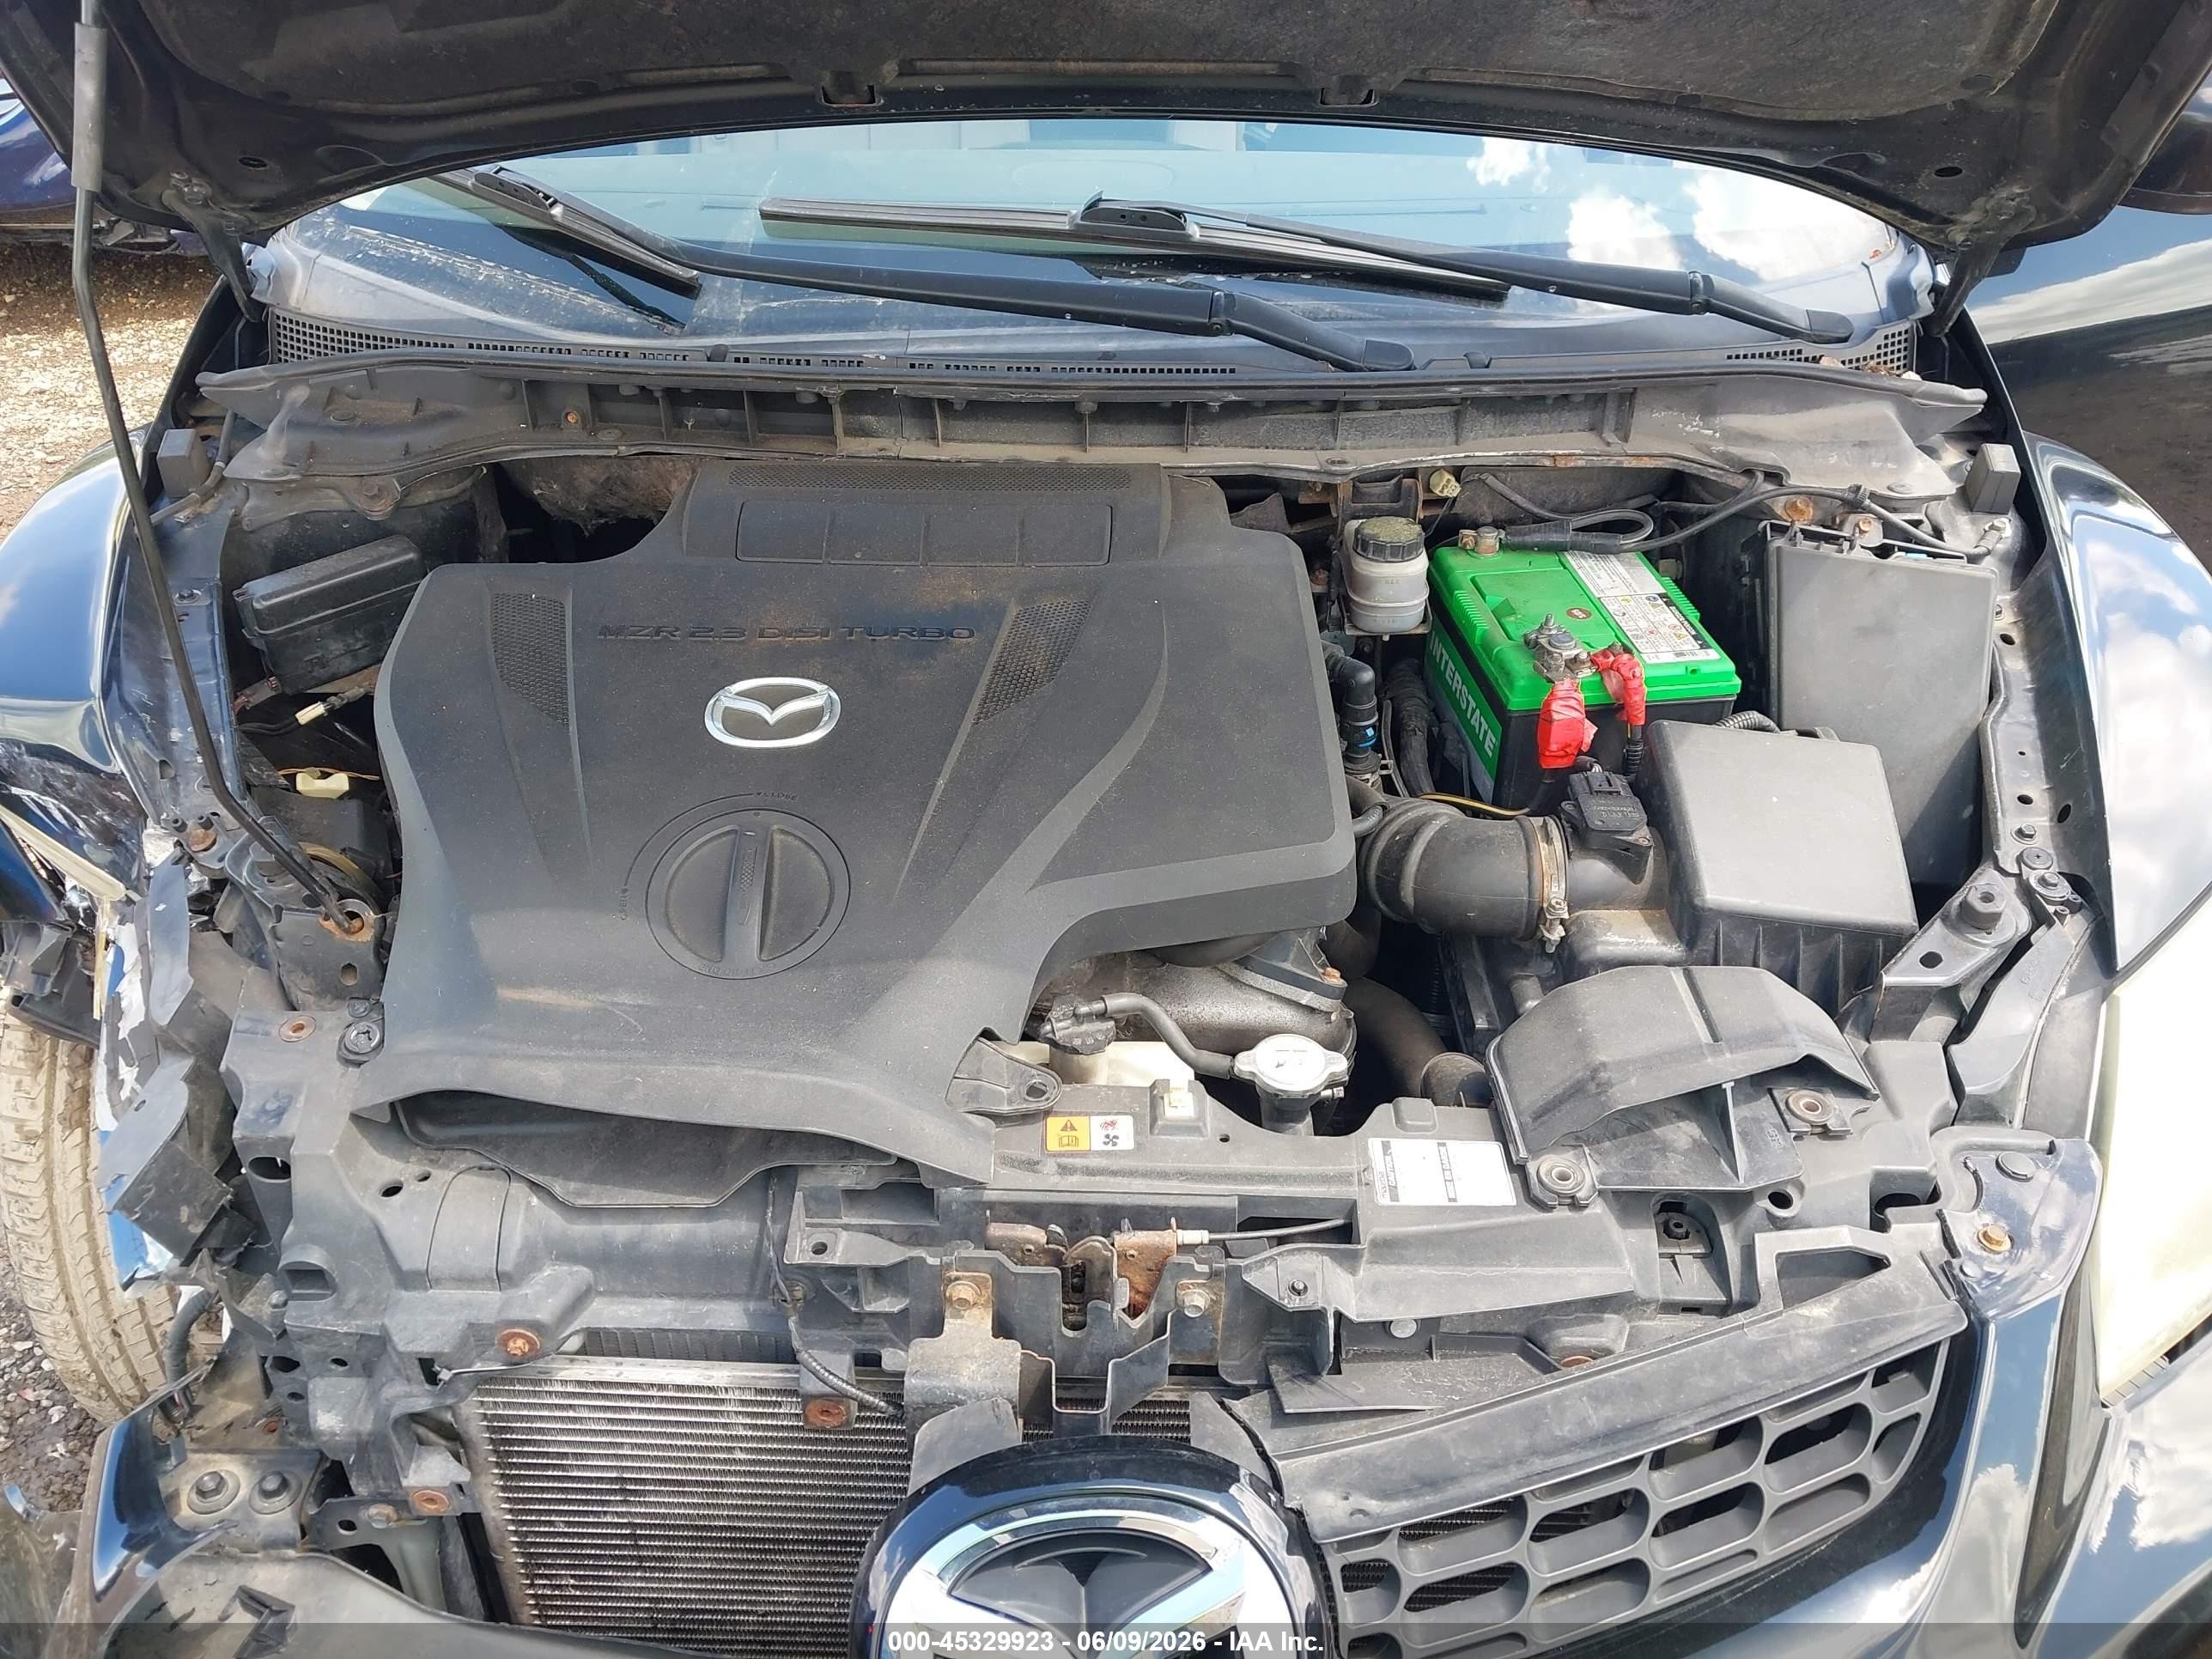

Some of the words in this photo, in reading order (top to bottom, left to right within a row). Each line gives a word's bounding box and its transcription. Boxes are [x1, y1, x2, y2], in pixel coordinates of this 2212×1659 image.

[599, 624, 681, 641] MZR
[688, 624, 747, 641] 2.3
[757, 625, 831, 641] DISI
[840, 625, 977, 641] TURBO
[1429, 631, 1496, 757] INTERSTATE
